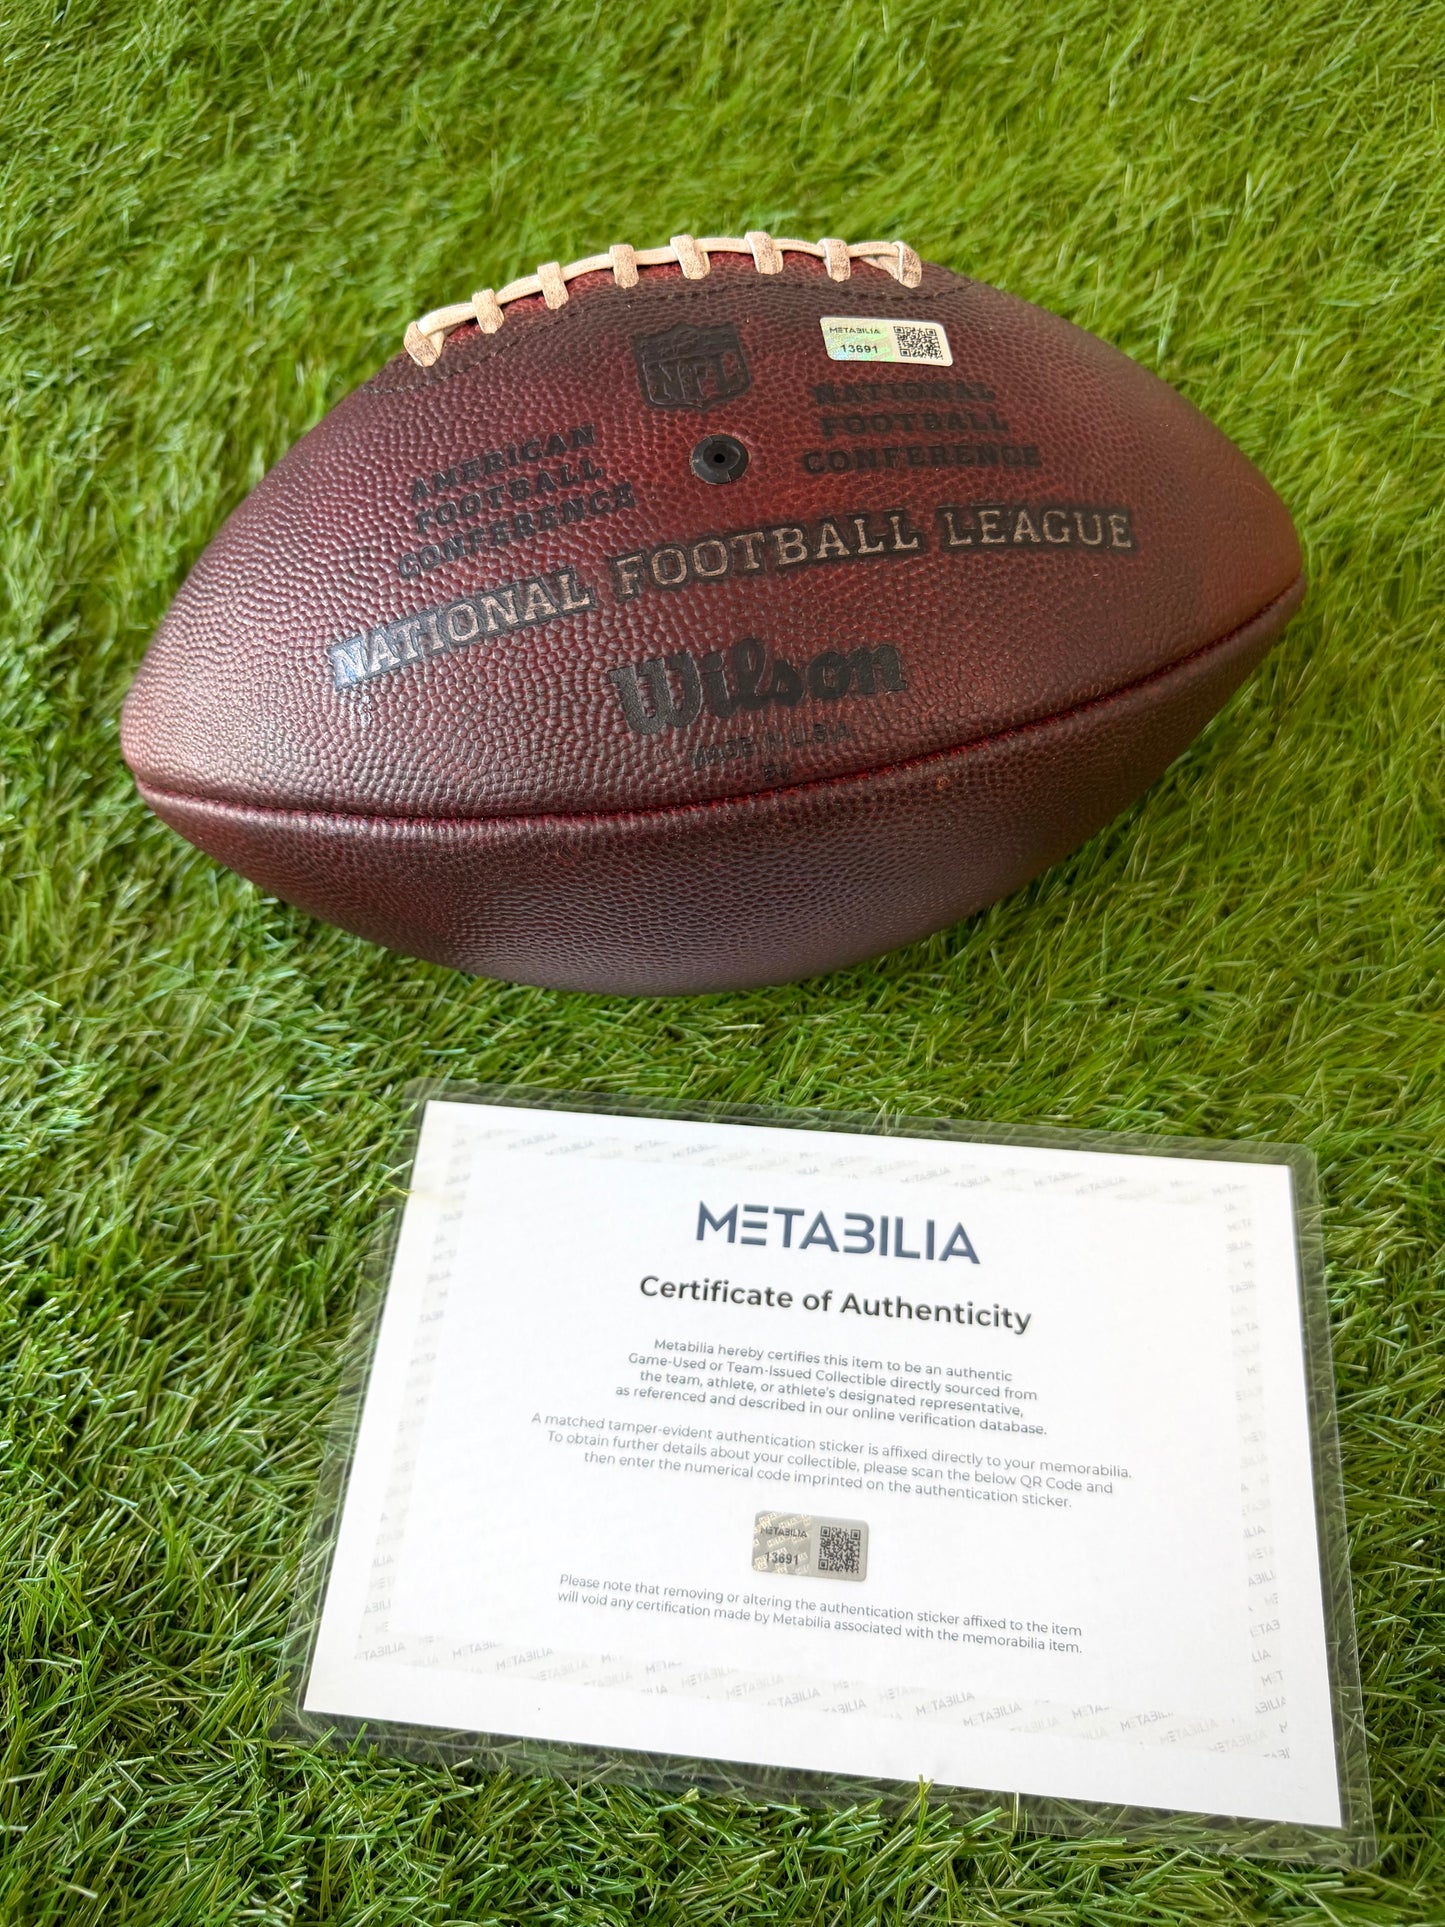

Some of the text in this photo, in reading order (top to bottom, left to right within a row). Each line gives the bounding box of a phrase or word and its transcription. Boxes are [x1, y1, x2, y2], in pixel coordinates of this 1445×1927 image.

[645, 352, 741, 402] NFL
[839, 343, 879, 354] 13691
[811, 382, 996, 405] NATIONAL
[820, 413, 1009, 440] FOOTBALL
[411, 423, 596, 503] AMERICAN
[802, 446, 1042, 474] CONFERENCE
[415, 458, 604, 534] FOOTBALL
[399, 482, 636, 579] CONFERENCE
[327, 503, 1138, 692] NATIONAL FOOTBALL LEAGUE
[607, 635, 907, 736] Wilson
[696, 1201, 981, 1264] METABILIA
[640, 1275, 1032, 1336] Certificate of Authenticity
[628, 1353, 1037, 1401] Game-Used or Team-Issued Collectible directly sourced from
[654, 1339, 1013, 1382] Metabilia hereby certifies this item to be an authentic
[616, 1386, 1047, 1435] as referenced and described in our online verification database.
[640, 1370, 663, 1383] the
[666, 1374, 703, 1388] team,
[707, 1377, 757, 1393] athlete,
[761, 1384, 775, 1393] or
[839, 1388, 916, 1407] designated
[920, 1399, 1023, 1419] representative,
[532, 1413, 1132, 1479] A matched tamper-evident authentication sticker is affixed directly to your memorabilia.
[549, 1431, 1113, 1494] To obtain further details about your collectible, please scan the below QR Code and
[585, 1452, 1072, 1508] then enter the numerical code imprinted on the authentication sticker.
[765, 1551, 800, 1566] 13691
[559, 1591, 1082, 1654] will void any certification made by Metabilia associated with the memorabilia item.
[560, 1574, 1082, 1637] Please note that removing or altering the authentication sticker affixed to the item
